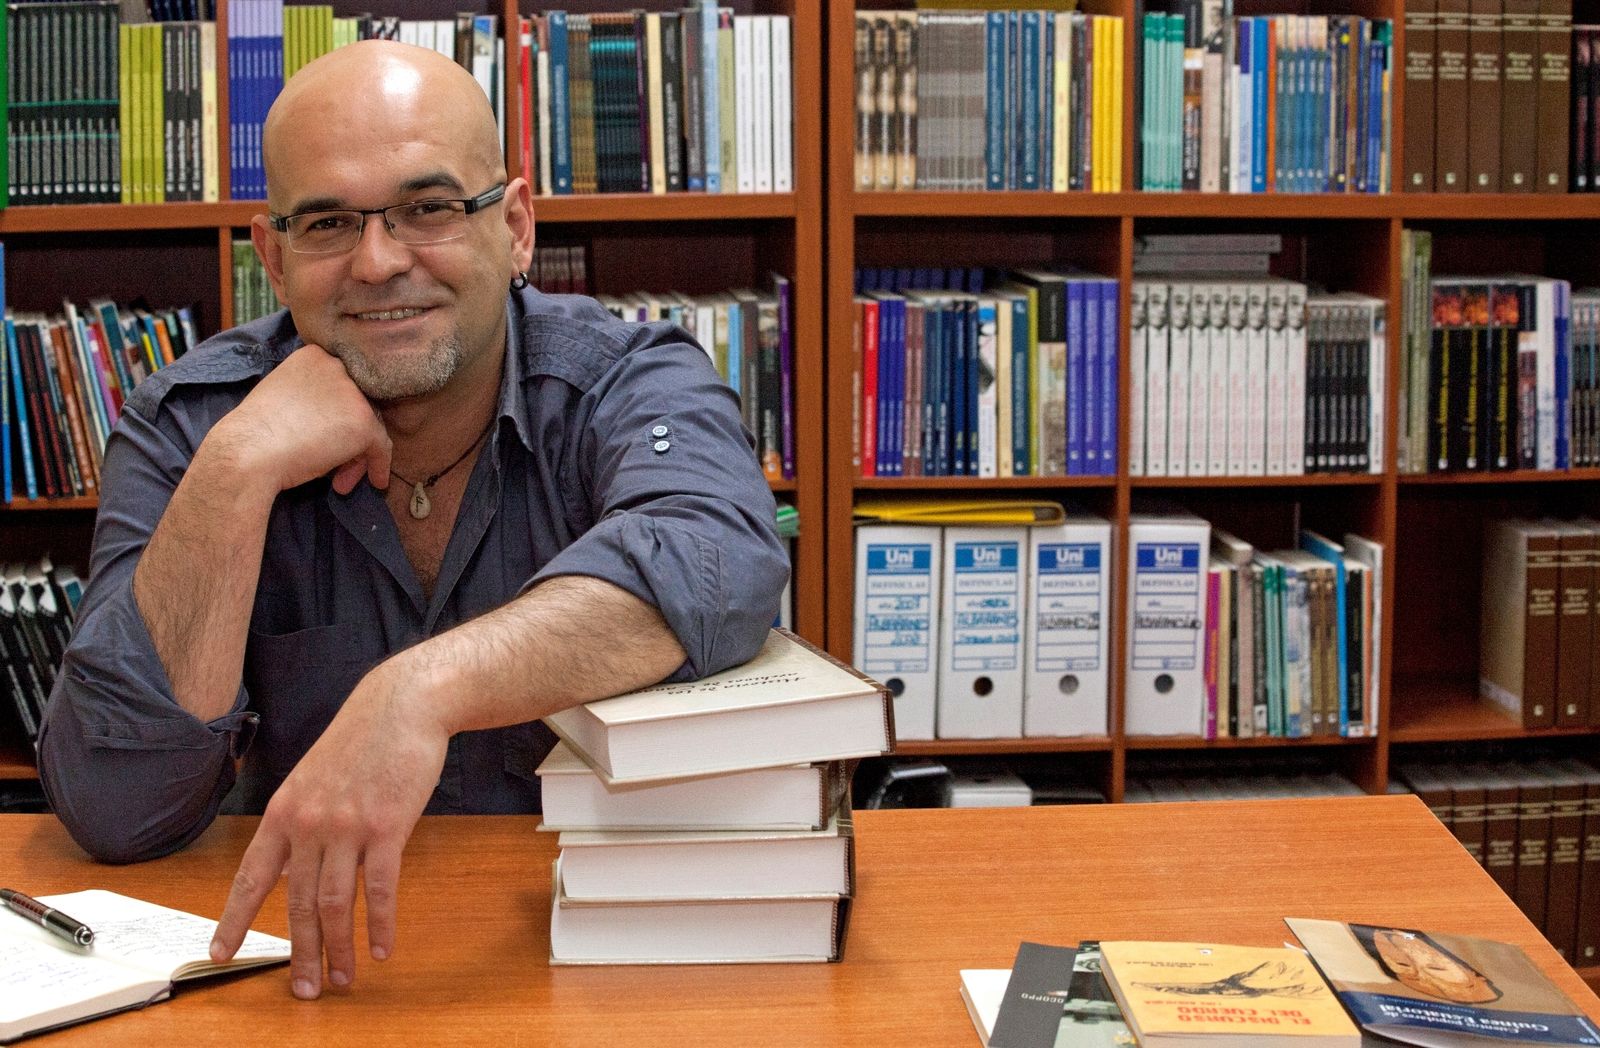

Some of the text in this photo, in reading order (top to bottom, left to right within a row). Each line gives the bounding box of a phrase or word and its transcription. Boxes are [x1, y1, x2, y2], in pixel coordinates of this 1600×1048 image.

[886, 549, 914, 563] Uni
[973, 547, 1001, 562] Uni
[1056, 548, 1084, 562] Uni
[1154, 547, 1183, 562] Uni
[1177, 1006, 1303, 1018] DEL CUERDO
[1379, 1003, 1470, 1023] Ecuatorial
[1177, 1014, 1280, 1025] DISCURSO
[1384, 1010, 1520, 1034] Cuentos populares de
[1480, 1018, 1549, 1032] Guinea
